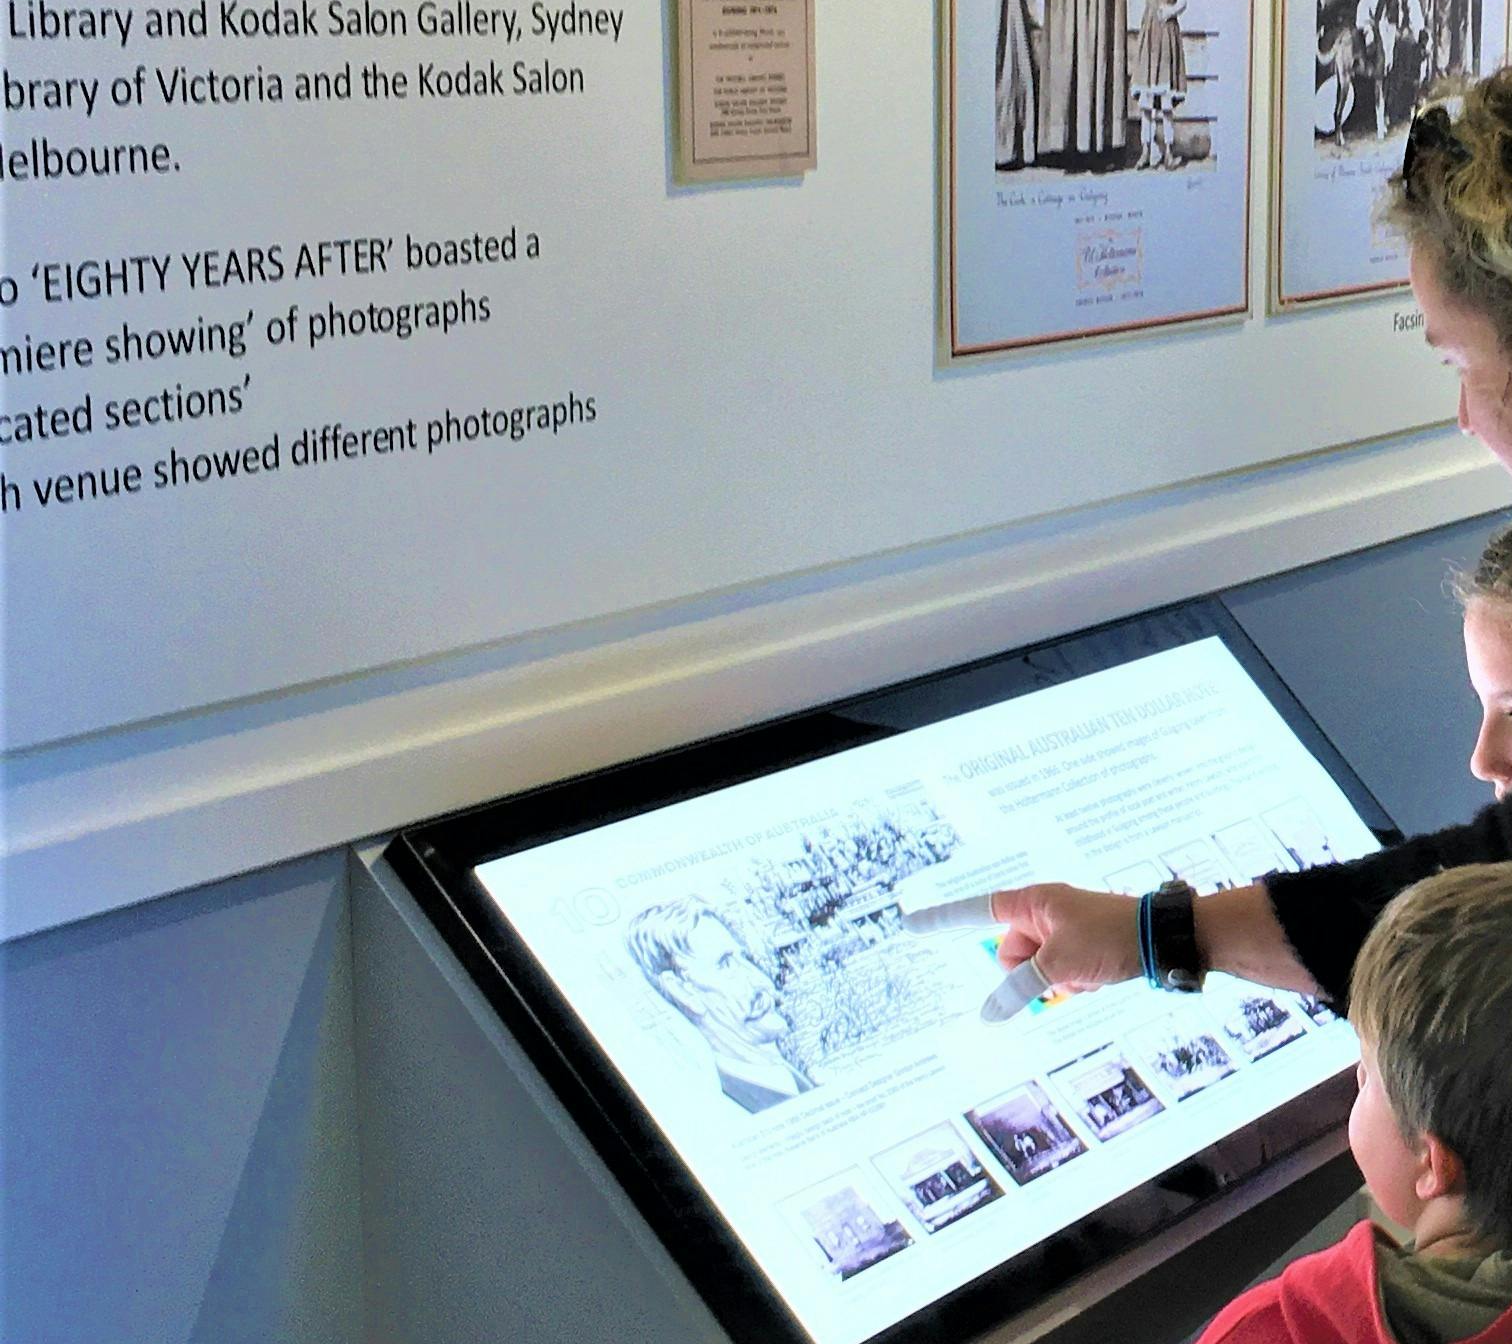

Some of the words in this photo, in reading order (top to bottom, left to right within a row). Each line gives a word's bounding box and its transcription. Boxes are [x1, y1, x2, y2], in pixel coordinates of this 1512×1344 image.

[146, 0, 207, 37] and
[221, 0, 318, 36] Kodak
[329, 0, 406, 36] Salon
[418, 0, 521, 43] Gallery,
[532, 1, 623, 42] Sydney
[182, 246, 284, 288] YEARS
[407, 227, 516, 268] boasted
[527, 234, 539, 258] a
[267, 306, 297, 344] of
[310, 290, 490, 348] photographs
[959, 744, 1030, 779] ORIGINAL
[1030, 715, 1112, 756] AUSTRALIAN
[1108, 703, 1139, 729] TEN
